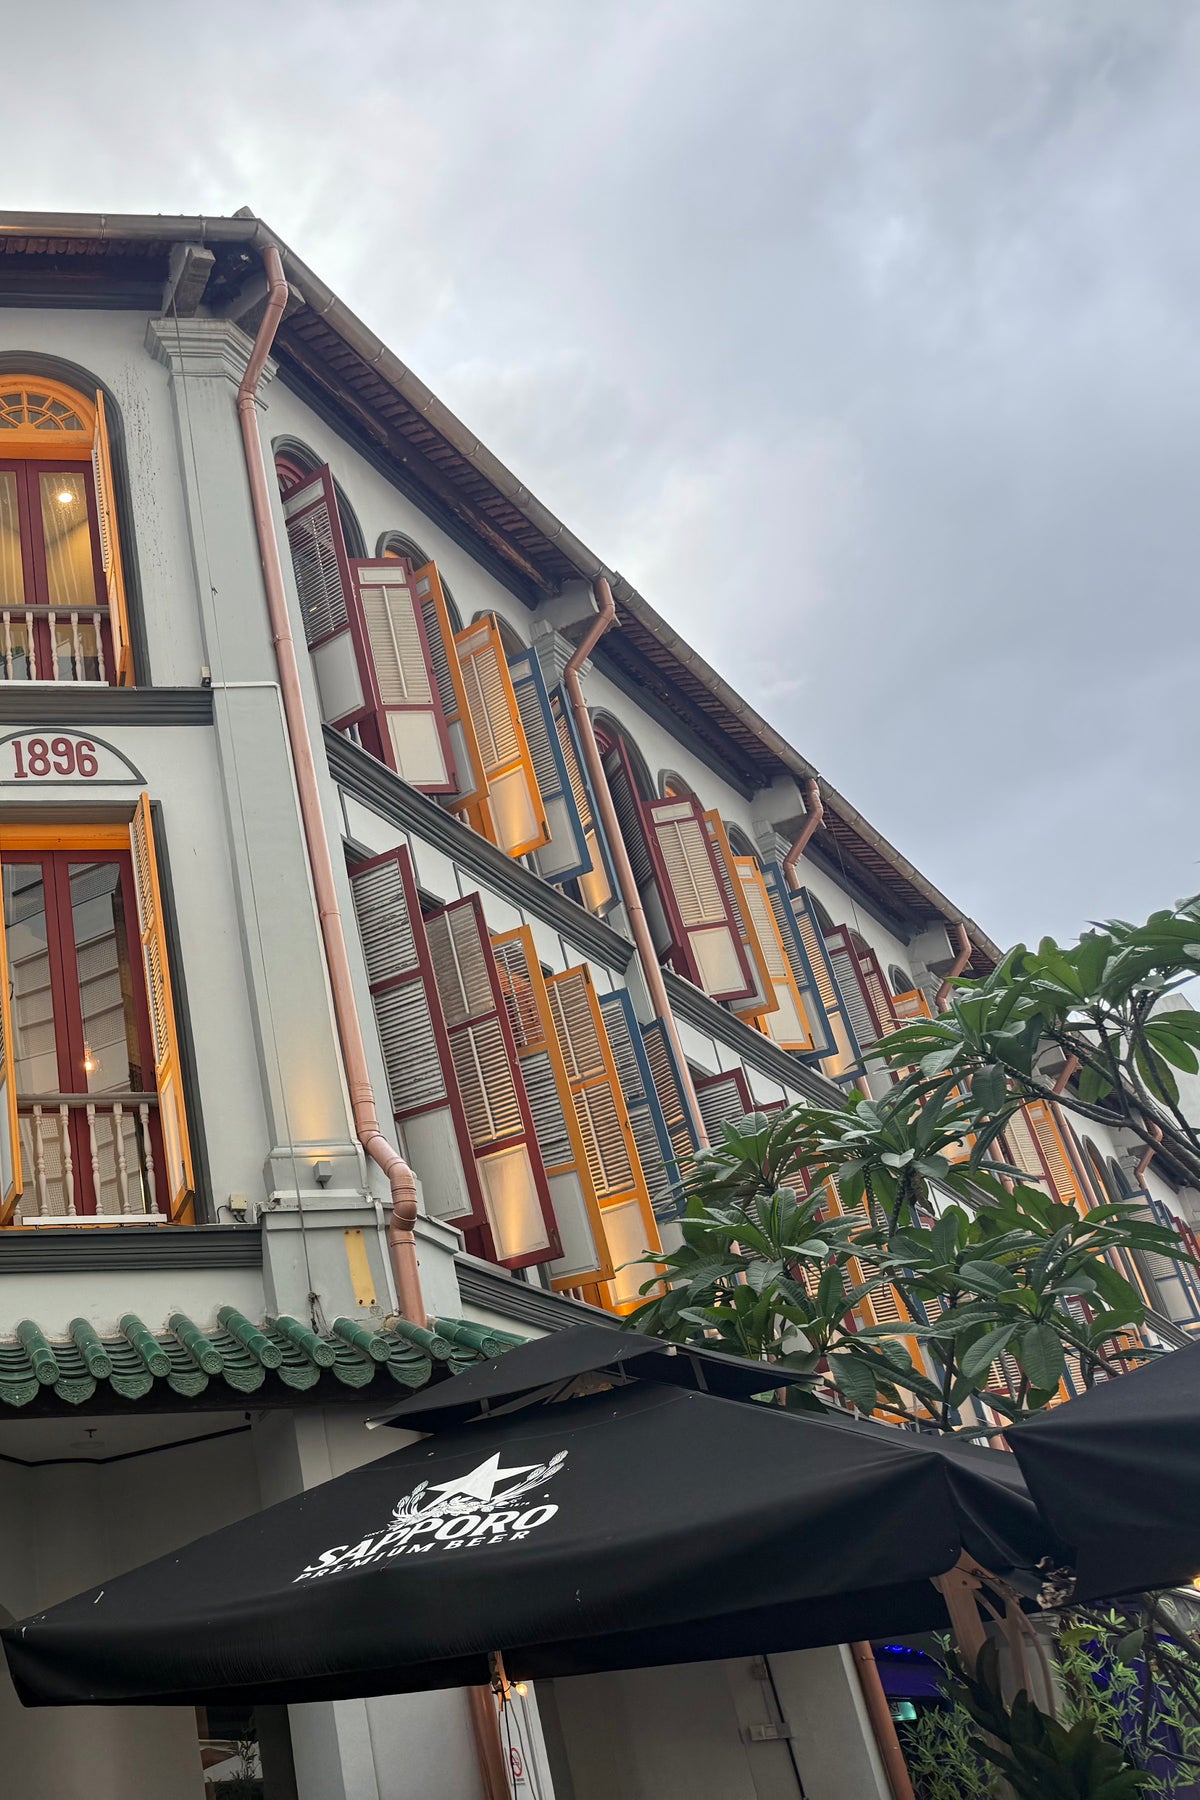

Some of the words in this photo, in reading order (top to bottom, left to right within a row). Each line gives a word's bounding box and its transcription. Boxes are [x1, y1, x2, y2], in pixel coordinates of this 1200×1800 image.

[12, 737, 98, 778] 1896
[292, 1542, 436, 1583] PREMIUM
[442, 1530, 531, 1550] BEER
[303, 1504, 559, 1572] SAPPORO
